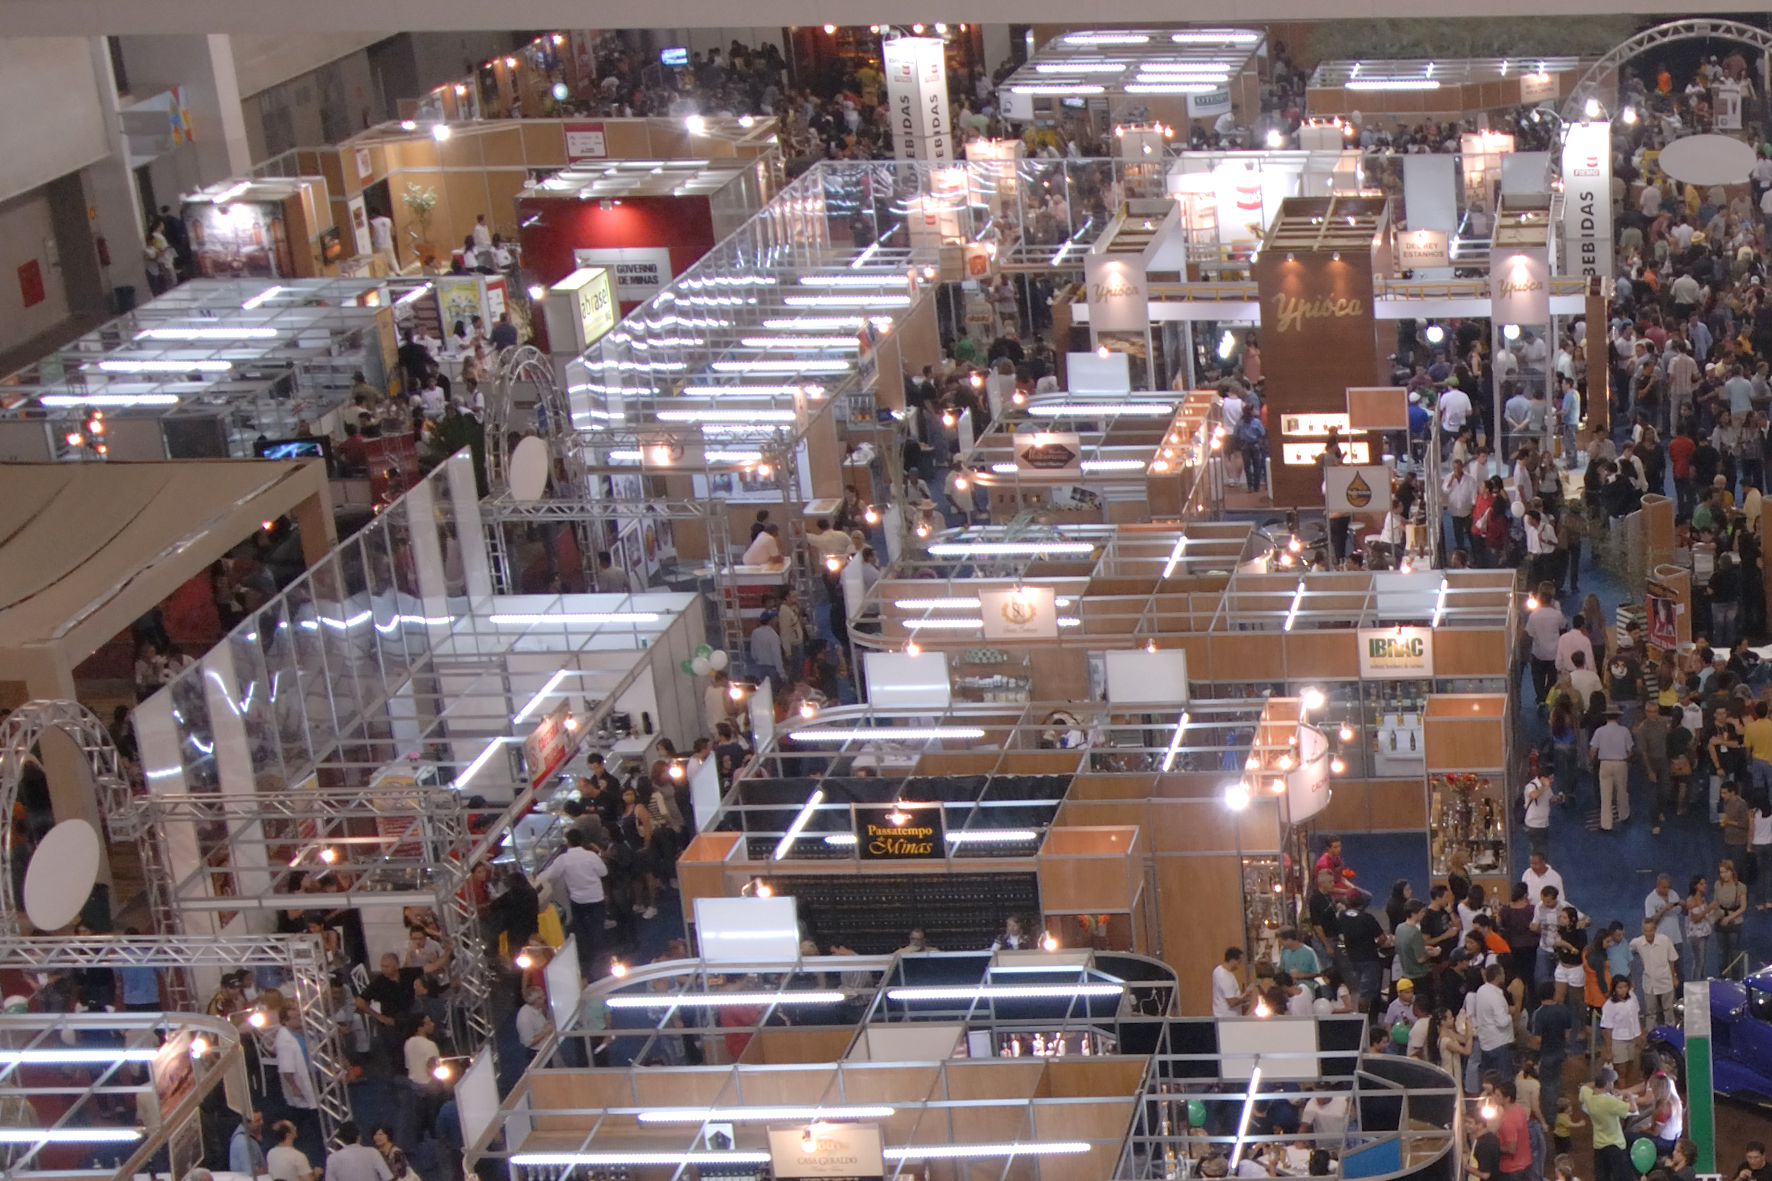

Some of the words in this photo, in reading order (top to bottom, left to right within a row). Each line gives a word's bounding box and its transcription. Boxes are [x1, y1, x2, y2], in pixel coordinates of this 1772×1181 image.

[617, 264, 657, 274] GOVERNO
[630, 275, 659, 285] MINAS
[1497, 278, 1543, 299] Ypióca
[582, 273, 609, 319] abrasel
[1093, 283, 1139, 304] Ypióca
[1271, 293, 1363, 332] Ypióca
[1369, 638, 1424, 658] IBRAC
[867, 825, 933, 838] Passatempo
[869, 837, 934, 855] Minas
[797, 1157, 818, 1165] CASA
[819, 1156, 858, 1166] GERALDO
